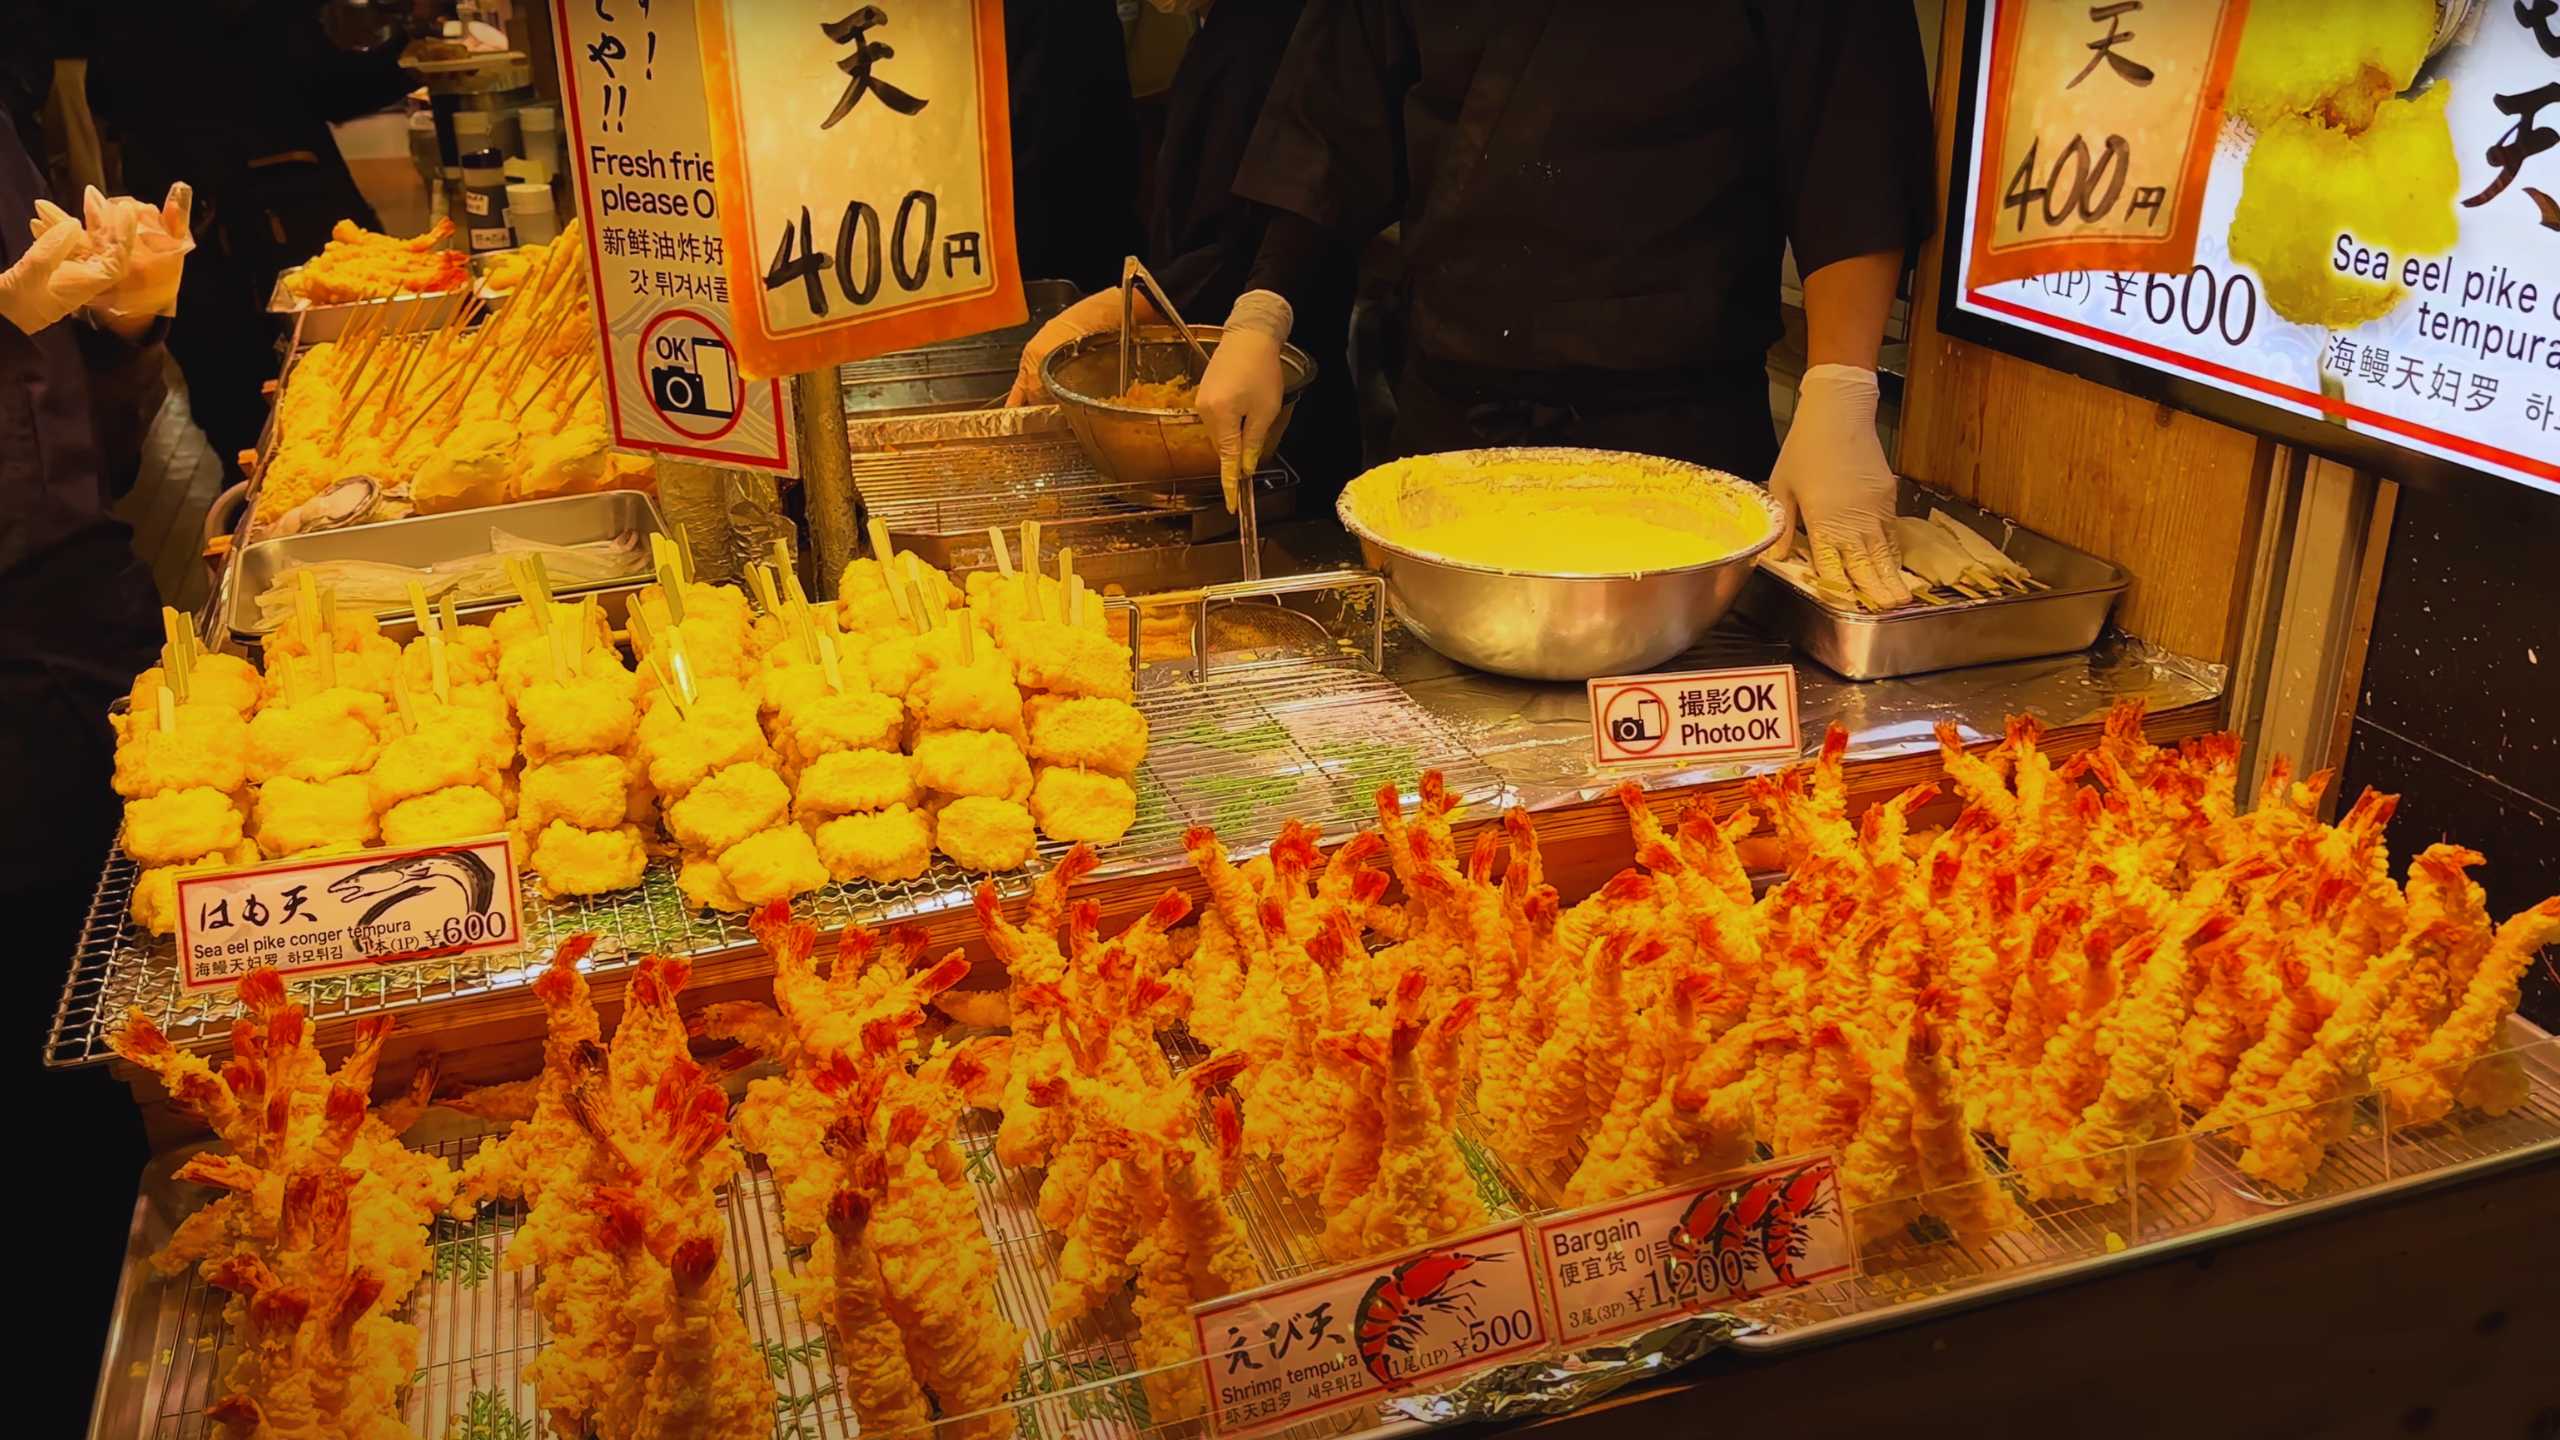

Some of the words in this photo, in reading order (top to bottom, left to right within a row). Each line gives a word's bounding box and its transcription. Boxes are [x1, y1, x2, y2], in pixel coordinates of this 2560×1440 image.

[2065, 1, 2155, 90] 天
[820, 5, 930, 130] 天
[591, 146, 666, 179] Fresh
[2004, 133, 2166, 232] 400円
[601, 183, 688, 217] please
[693, 188, 720, 219] O
[603, 226, 724, 266] 新鲜油炸好
[763, 190, 980, 318] 400円
[629, 269, 649, 296] 갓
[2333, 234, 2390, 281] Sea
[2402, 256, 2453, 294] eel
[2461, 265, 2538, 314] pike
[2021, 269, 2091, 306] (1P)
[2105, 264, 2257, 346] ¥600
[656, 335, 689, 363] OK
[2418, 302, 2560, 370] tempura
[2324, 335, 2500, 413] 海鳗天妇罗
[2525, 392, 2560, 432] 하
[1678, 683, 1777, 718] 撮影OK
[1681, 722, 1746, 747] Photo
[1749, 717, 1781, 741] OK
[200, 884, 318, 933] はも天
[194, 944, 223, 959] Sea
[227, 939, 249, 956] eel
[254, 935, 286, 954] pike
[290, 928, 343, 946] conger
[347, 920, 411, 939] tempura
[424, 911, 506, 948] ¥600
[288, 945, 343, 966] 하모튀김
[1553, 1218, 1641, 1257] Bargain
[1559, 1250, 1628, 1288] 便宜货
[1626, 1249, 1743, 1313] ¥1,200
[1226, 1301, 1346, 1375] えび天
[1452, 1309, 1533, 1359] ¥500
[1221, 1376, 1282, 1405] Shrimp
[1287, 1353, 1358, 1384] tempura
[1306, 1371, 1363, 1399] 새우튀김
